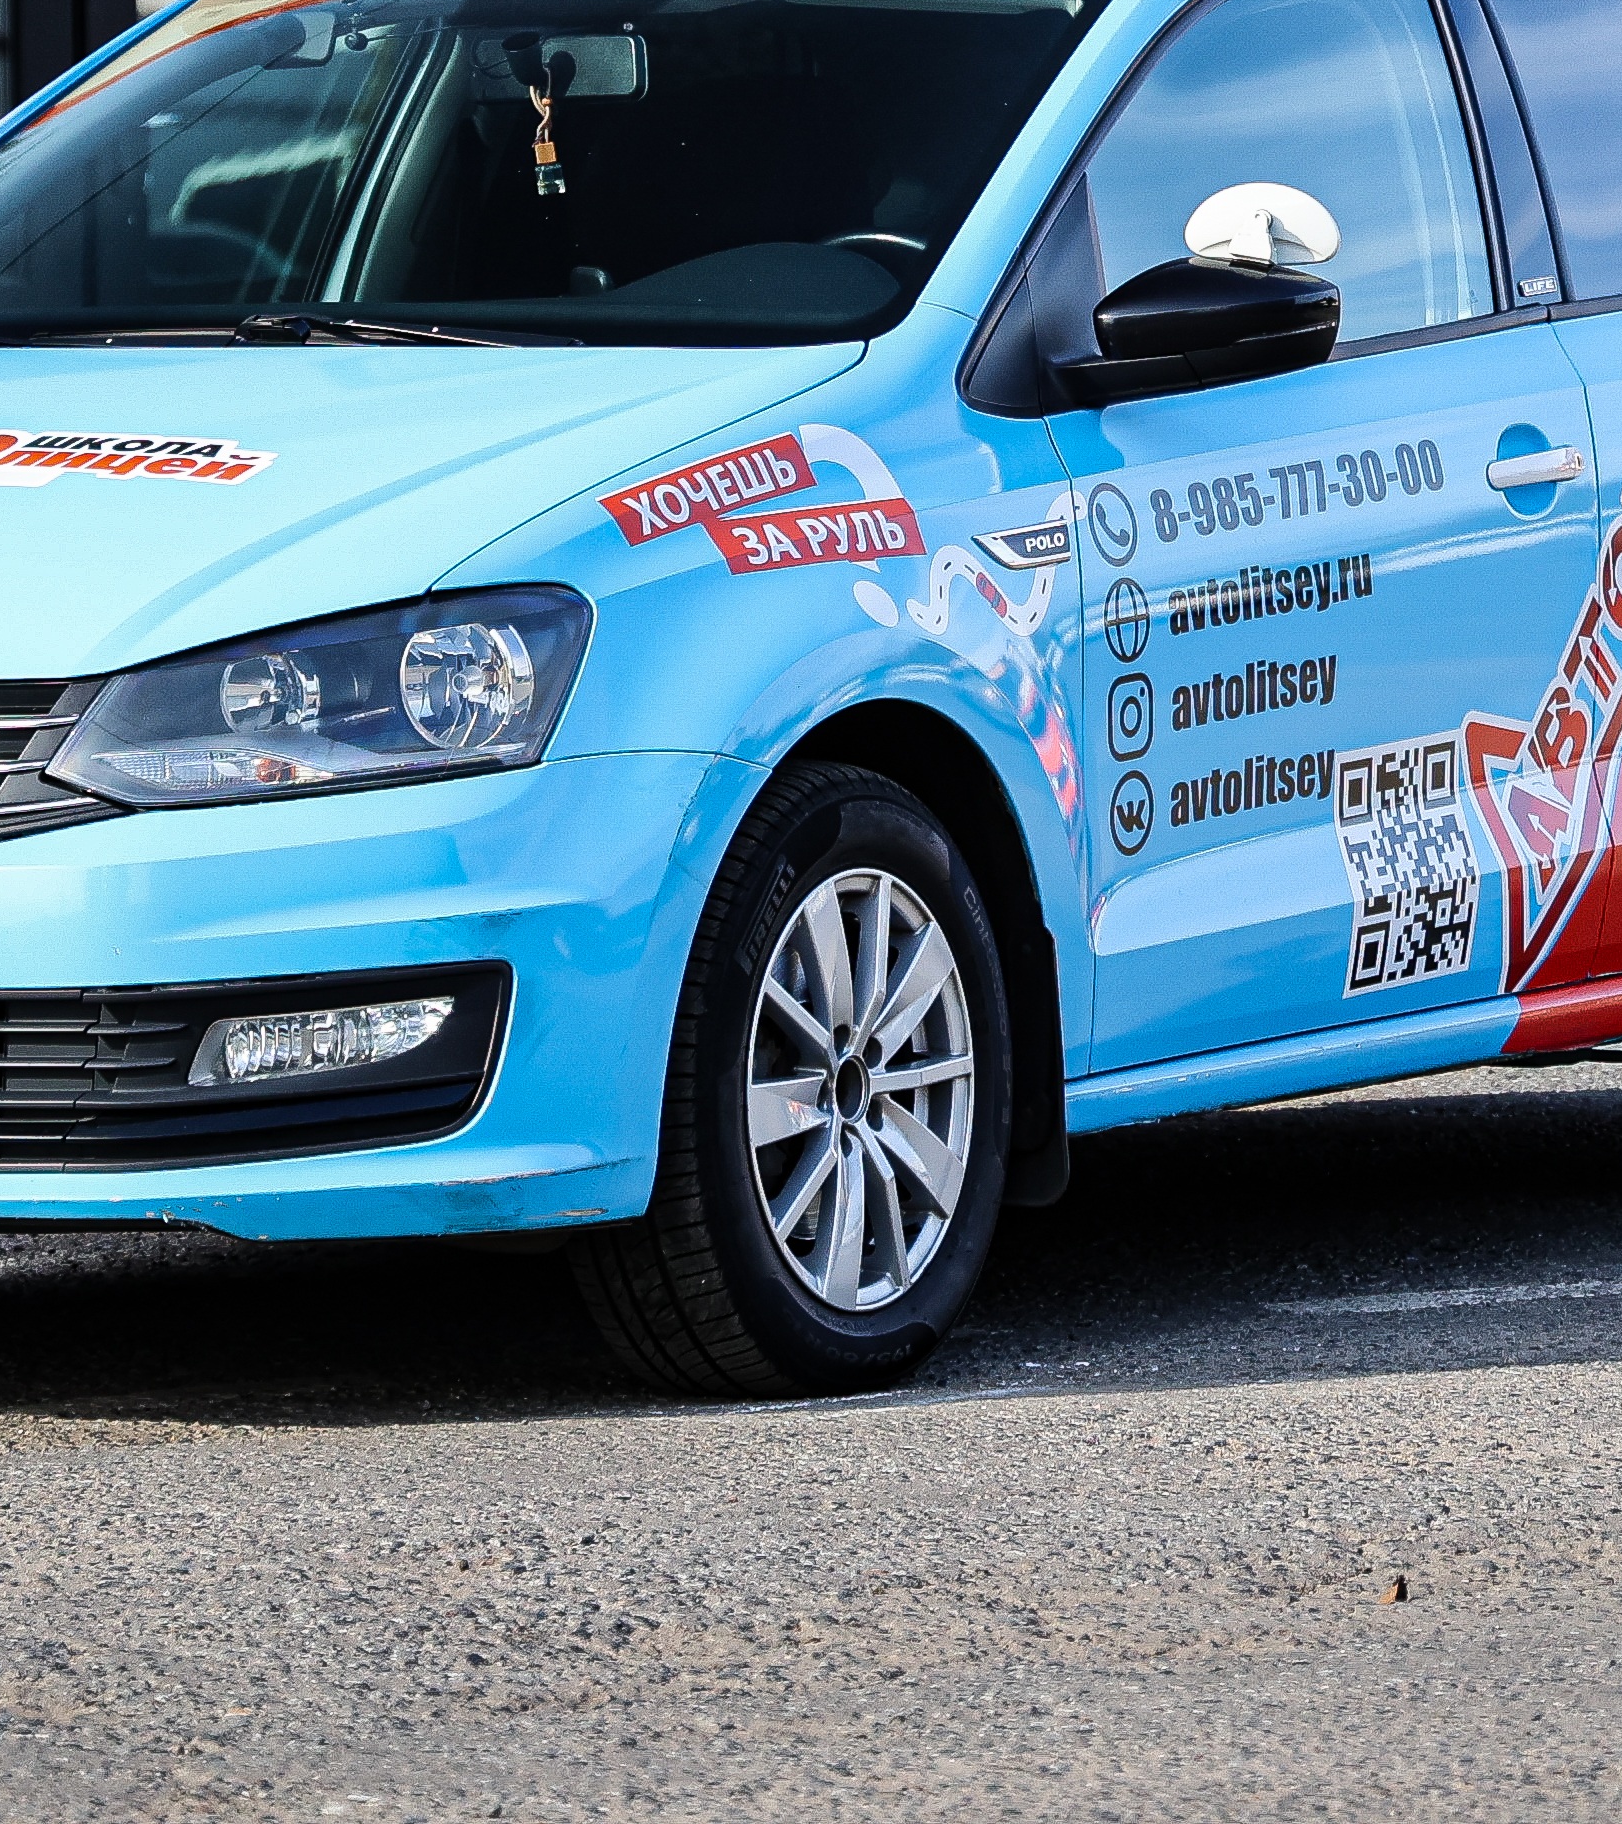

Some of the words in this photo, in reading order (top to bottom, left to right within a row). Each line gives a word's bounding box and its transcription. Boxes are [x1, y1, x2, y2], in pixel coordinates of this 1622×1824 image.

[1524, 278, 1555, 293] LIFE
[20, 434, 220, 459] ШКОЛА
[621, 446, 797, 536] ХОЧЕШЬ
[1149, 439, 1445, 544] 8-985-777-30-00
[731, 526, 798, 566] ЗА
[798, 514, 907, 559] РУЛЬ
[1024, 532, 1066, 554] POLO
[1168, 553, 1373, 636] avtolitsey.ru
[1171, 654, 1338, 732] avtolitsey
[1170, 748, 1336, 828] avtolitsey
